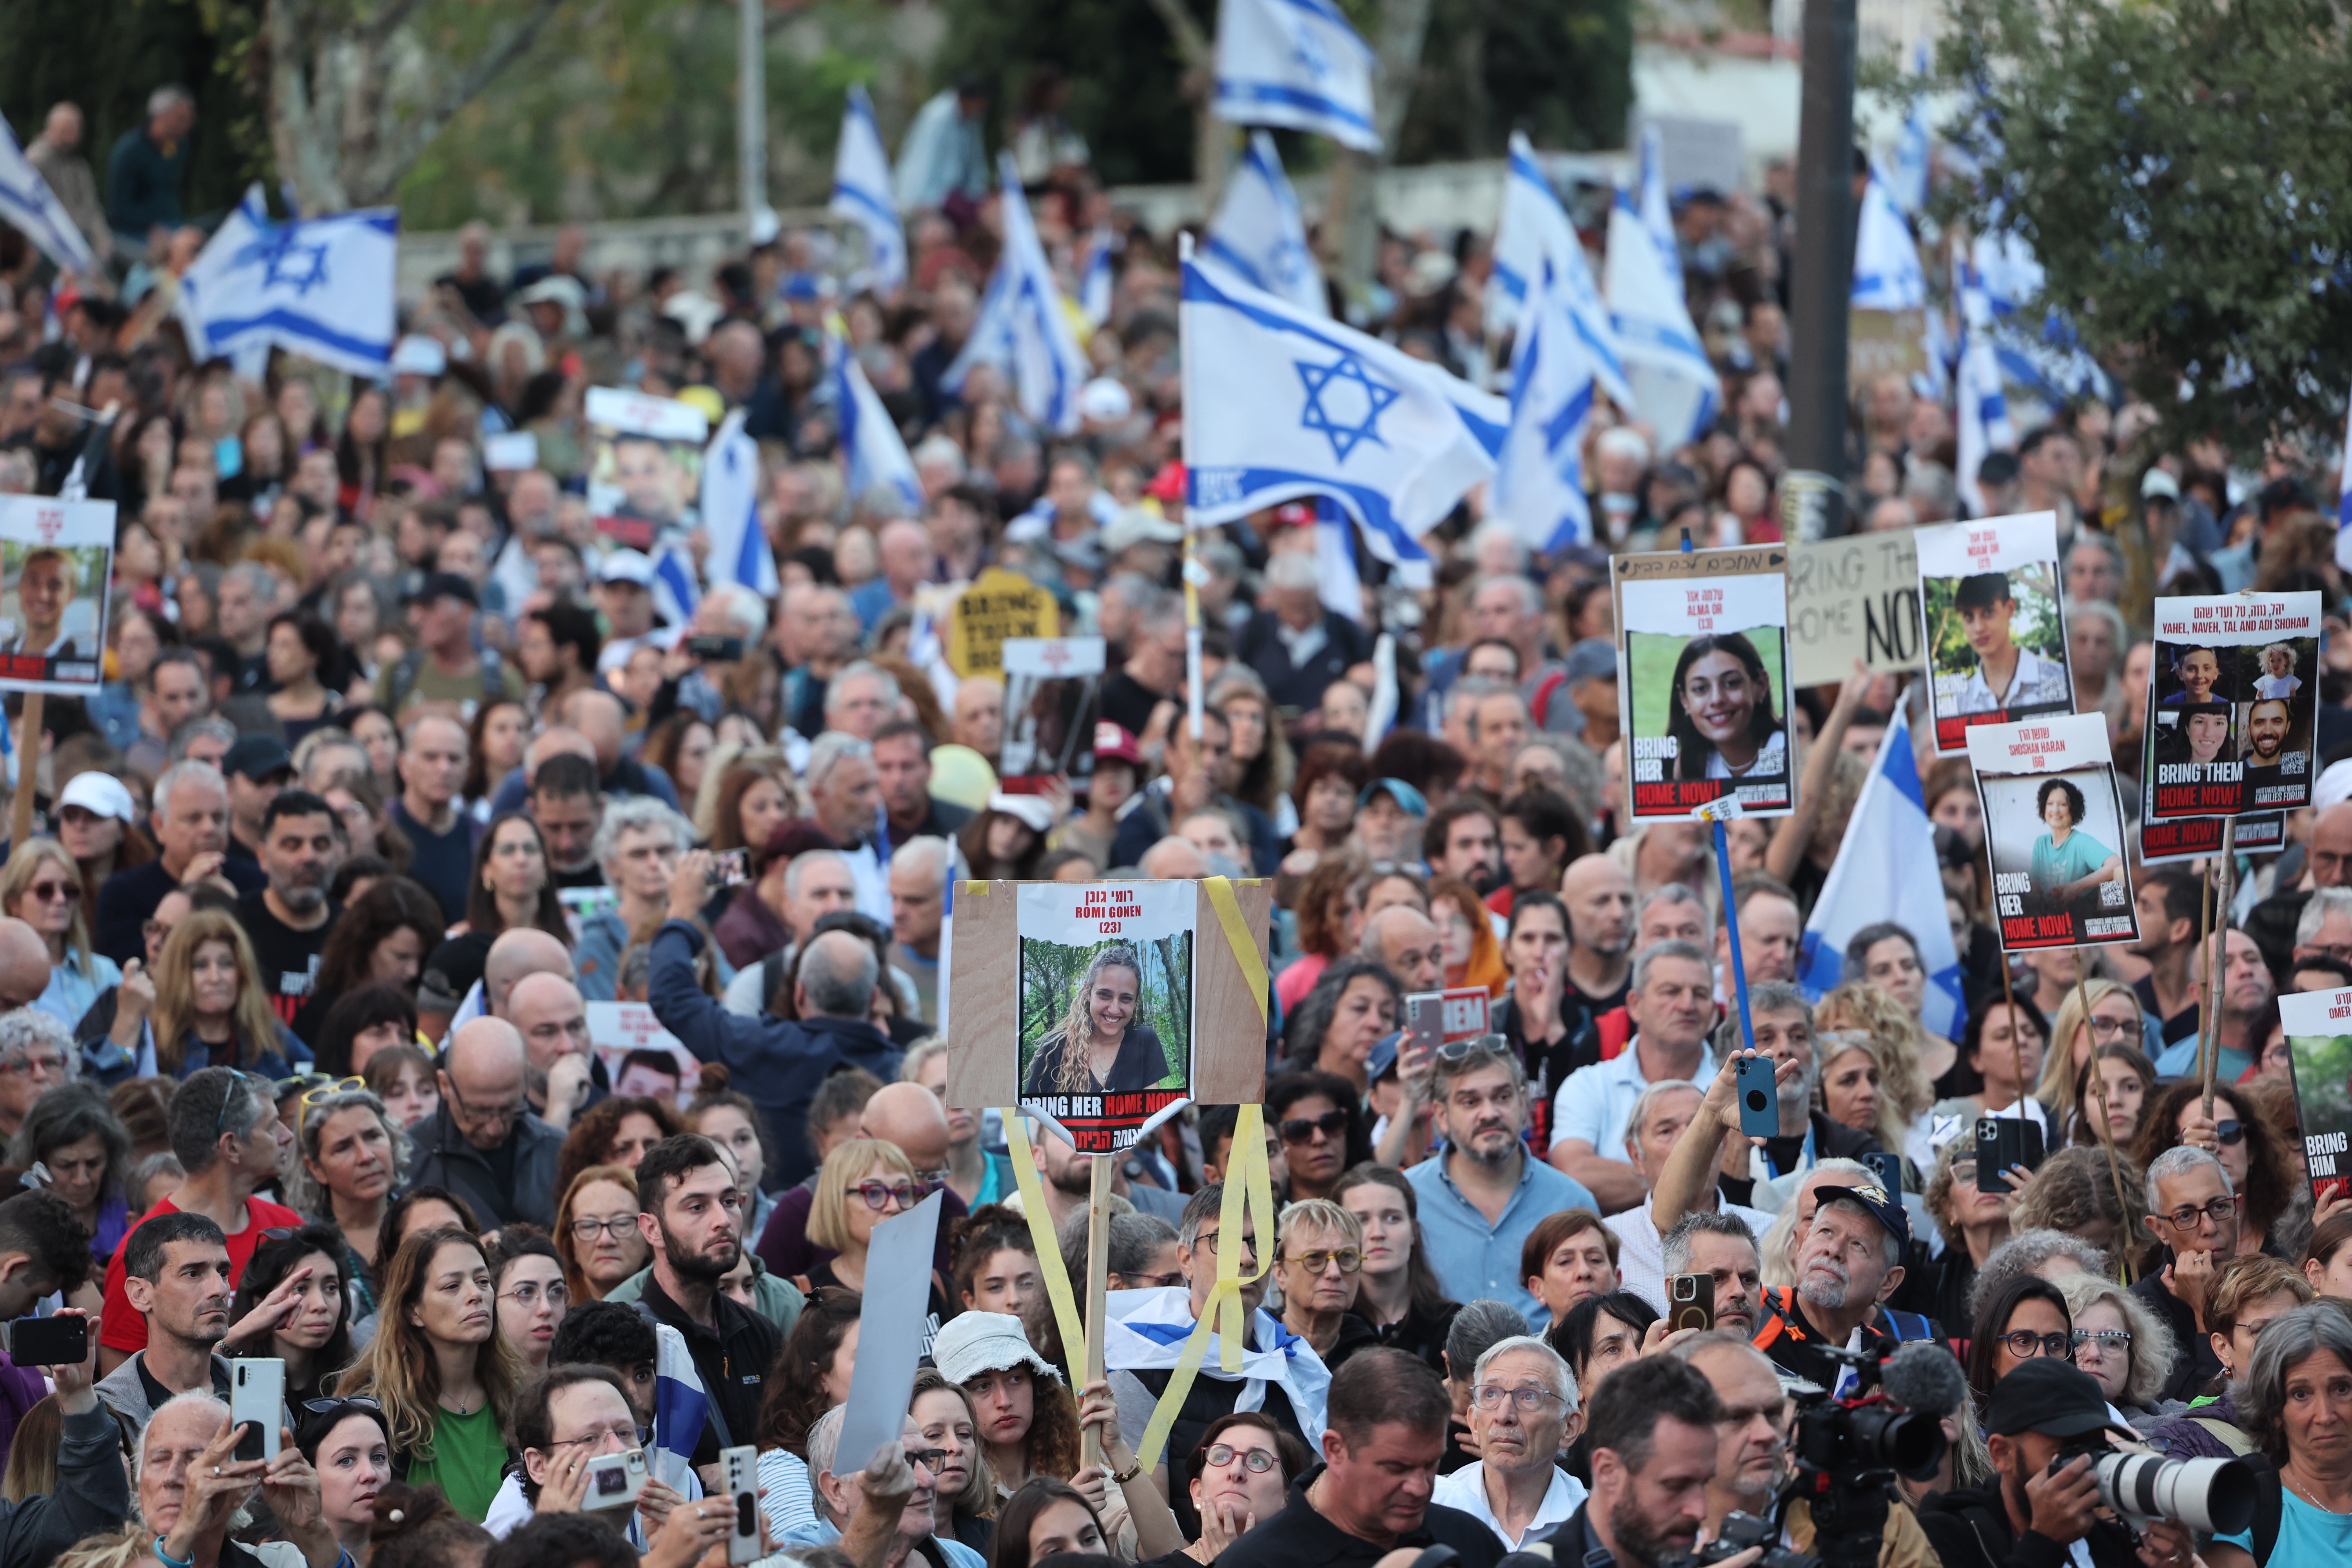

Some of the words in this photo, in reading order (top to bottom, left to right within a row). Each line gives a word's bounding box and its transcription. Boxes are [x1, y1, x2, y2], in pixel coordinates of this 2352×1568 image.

[1687, 604, 1710, 616] ALMA
[1712, 603, 1723, 615] OR
[2194, 607, 2212, 619] שהם
[2216, 606, 2232, 618] ועדי
[2235, 605, 2246, 617] טל
[2248, 604, 2266, 619] נווה,
[2269, 603, 2285, 618] יהל,
[1790, 599, 1853, 644] OME
[1864, 586, 1921, 665] NO
[2163, 622, 2189, 636] YAHEL,
[2192, 621, 2221, 635] NAVEH,
[2223, 621, 2238, 633] TAL
[2240, 620, 2256, 632] AND
[2259, 619, 2272, 631] ADI
[2275, 617, 2309, 630] SHOHAM
[1934, 671, 1968, 695] BRING
[2018, 729, 2031, 742] הרן
[2031, 727, 2050, 740] שושן
[1634, 735, 1678, 759] BRING
[2009, 742, 2040, 756] SHOSHAN
[2041, 739, 2065, 753] HARAN
[1635, 759, 1664, 782] HER
[2159, 763, 2201, 784] BRING
[2205, 761, 2243, 782] THEM
[1635, 783, 1677, 806] HOME
[1679, 779, 1721, 805] NOW!
[2158, 786, 2197, 808] HOME
[2201, 783, 2241, 806] NOW!
[2287, 783, 2305, 792] MISSING
[2255, 792, 2282, 804] FAMILIES
[2283, 790, 2305, 801] FORUM
[2144, 825, 2179, 848] HOME
[2182, 819, 2219, 844] NOW!
[1996, 872, 2031, 895] BRING
[1085, 891, 1107, 906] גונן
[1111, 890, 1133, 902] רומי
[1076, 906, 1105, 918] ROMI
[1109, 905, 1141, 918] GONEN
[1999, 894, 2024, 916] HER
[1099, 922, 1121, 933] (23)
[2003, 917, 2038, 939] HOME
[2038, 911, 2074, 936] NOW!
[2335, 992, 2352, 1005] קרט
[2329, 1005, 2351, 1019] OMER
[1072, 1096, 1102, 1116] HER
[1105, 1093, 1143, 1116] HOME
[2305, 1131, 2348, 1157] BRING
[2308, 1154, 2337, 1178] HIM
